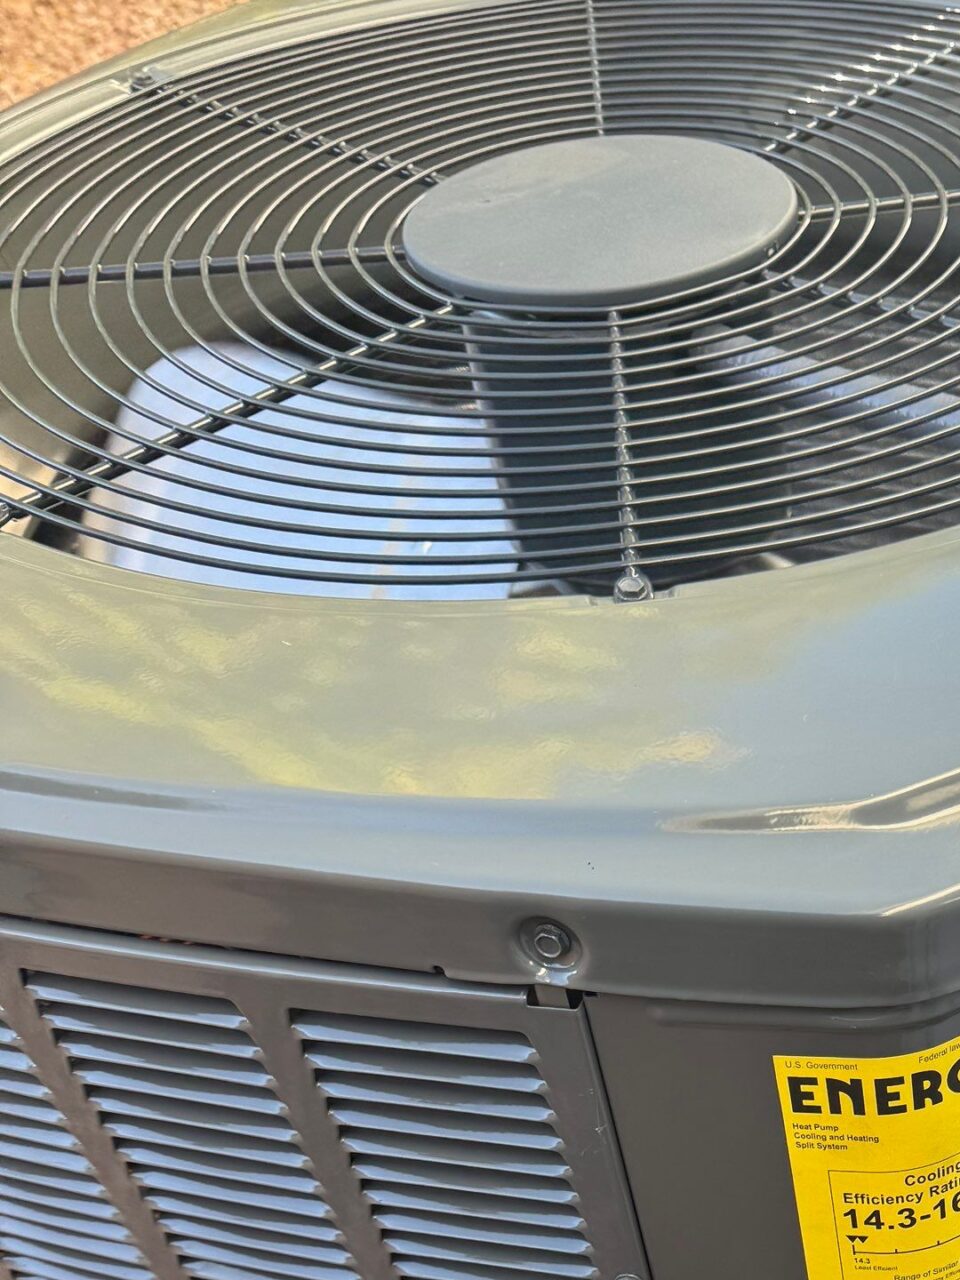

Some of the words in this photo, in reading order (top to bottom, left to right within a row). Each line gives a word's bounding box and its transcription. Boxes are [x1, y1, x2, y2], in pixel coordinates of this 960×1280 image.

[918, 1049, 948, 1063] Federal
[785, 1061, 801, 1069] U.S.
[806, 1061, 858, 1071] Government
[793, 1123, 812, 1131] Heat
[814, 1124, 839, 1132] Pump
[794, 1132, 827, 1142] Cooling
[847, 1134, 880, 1144] Heating
[795, 1141, 815, 1150] Split
[817, 1142, 848, 1151] System
[843, 1192, 924, 1206] Efficiency
[854, 1257, 871, 1265] 14.3
[922, 1270, 931, 1278] of
[932, 1259, 958, 1276] Similar
